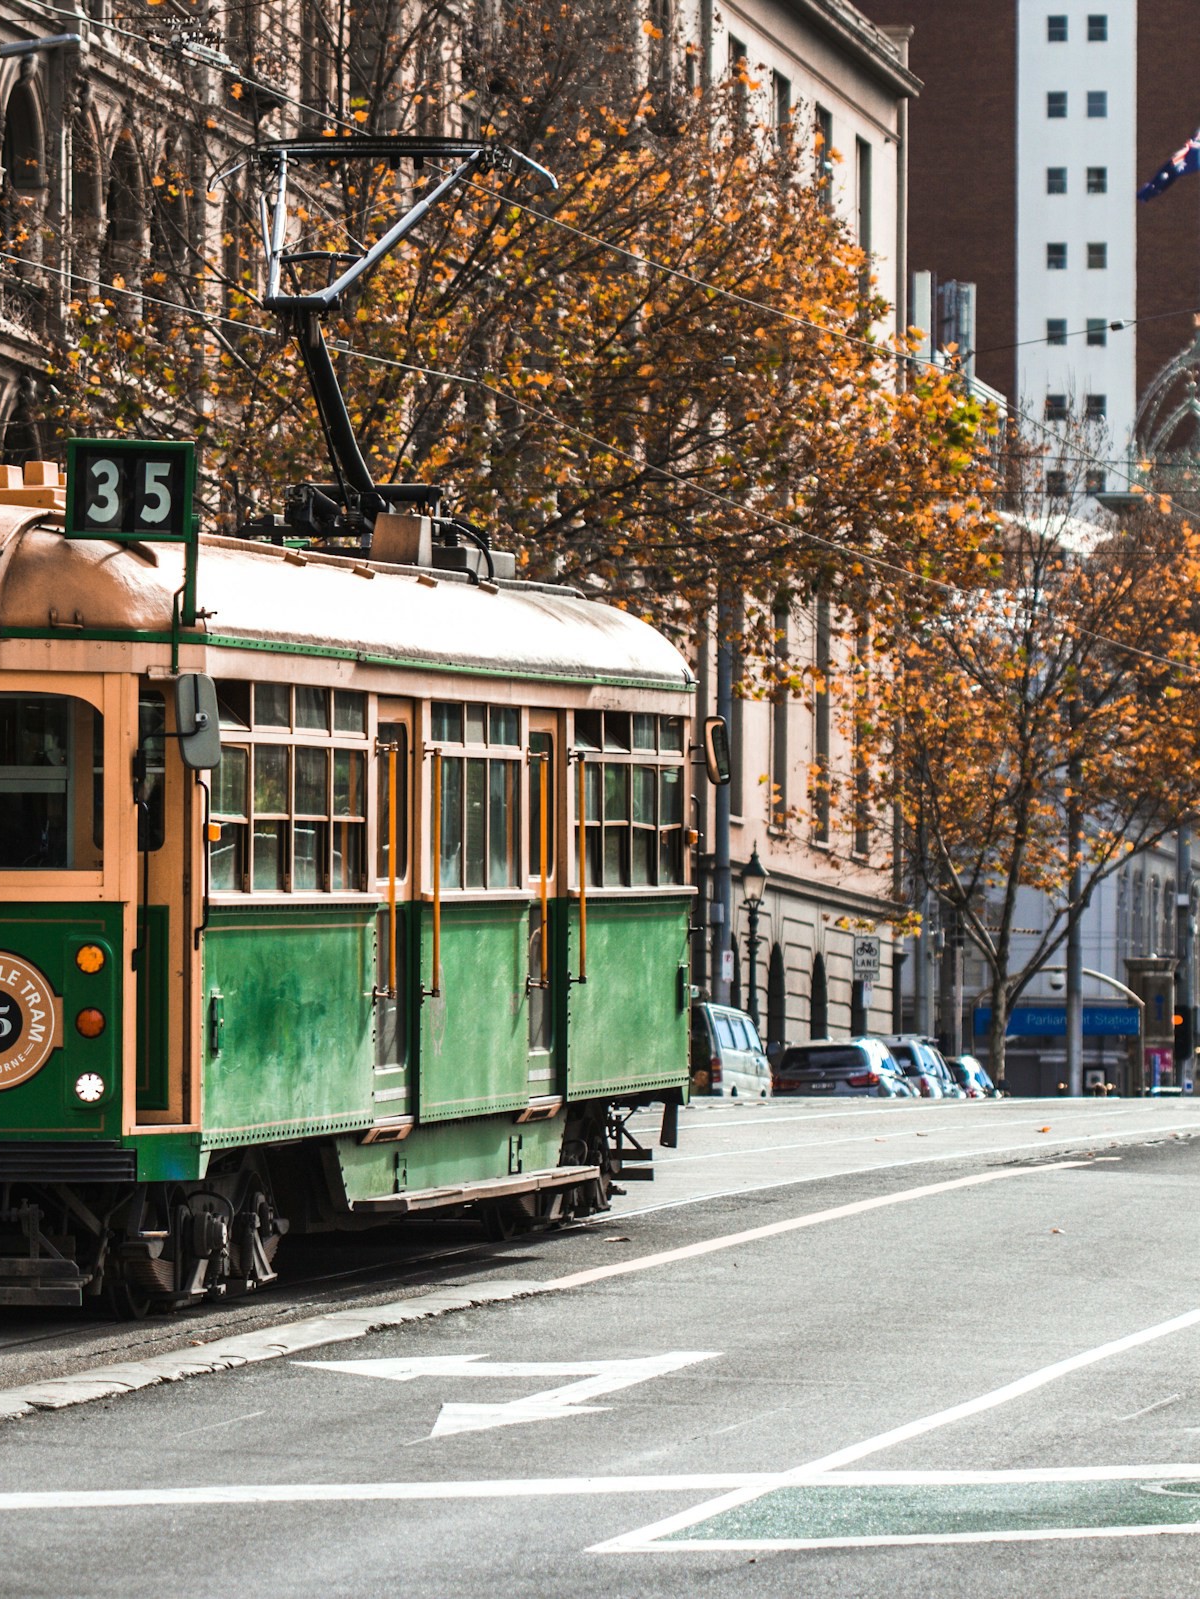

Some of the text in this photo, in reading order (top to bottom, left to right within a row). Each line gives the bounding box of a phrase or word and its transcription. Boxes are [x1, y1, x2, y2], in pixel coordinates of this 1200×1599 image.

[86, 458, 171, 524] 35
[855, 959, 878, 968] LANE
[20, 980, 46, 1043] TRAM
[1026, 1012, 1138, 1026] Parliat Station
